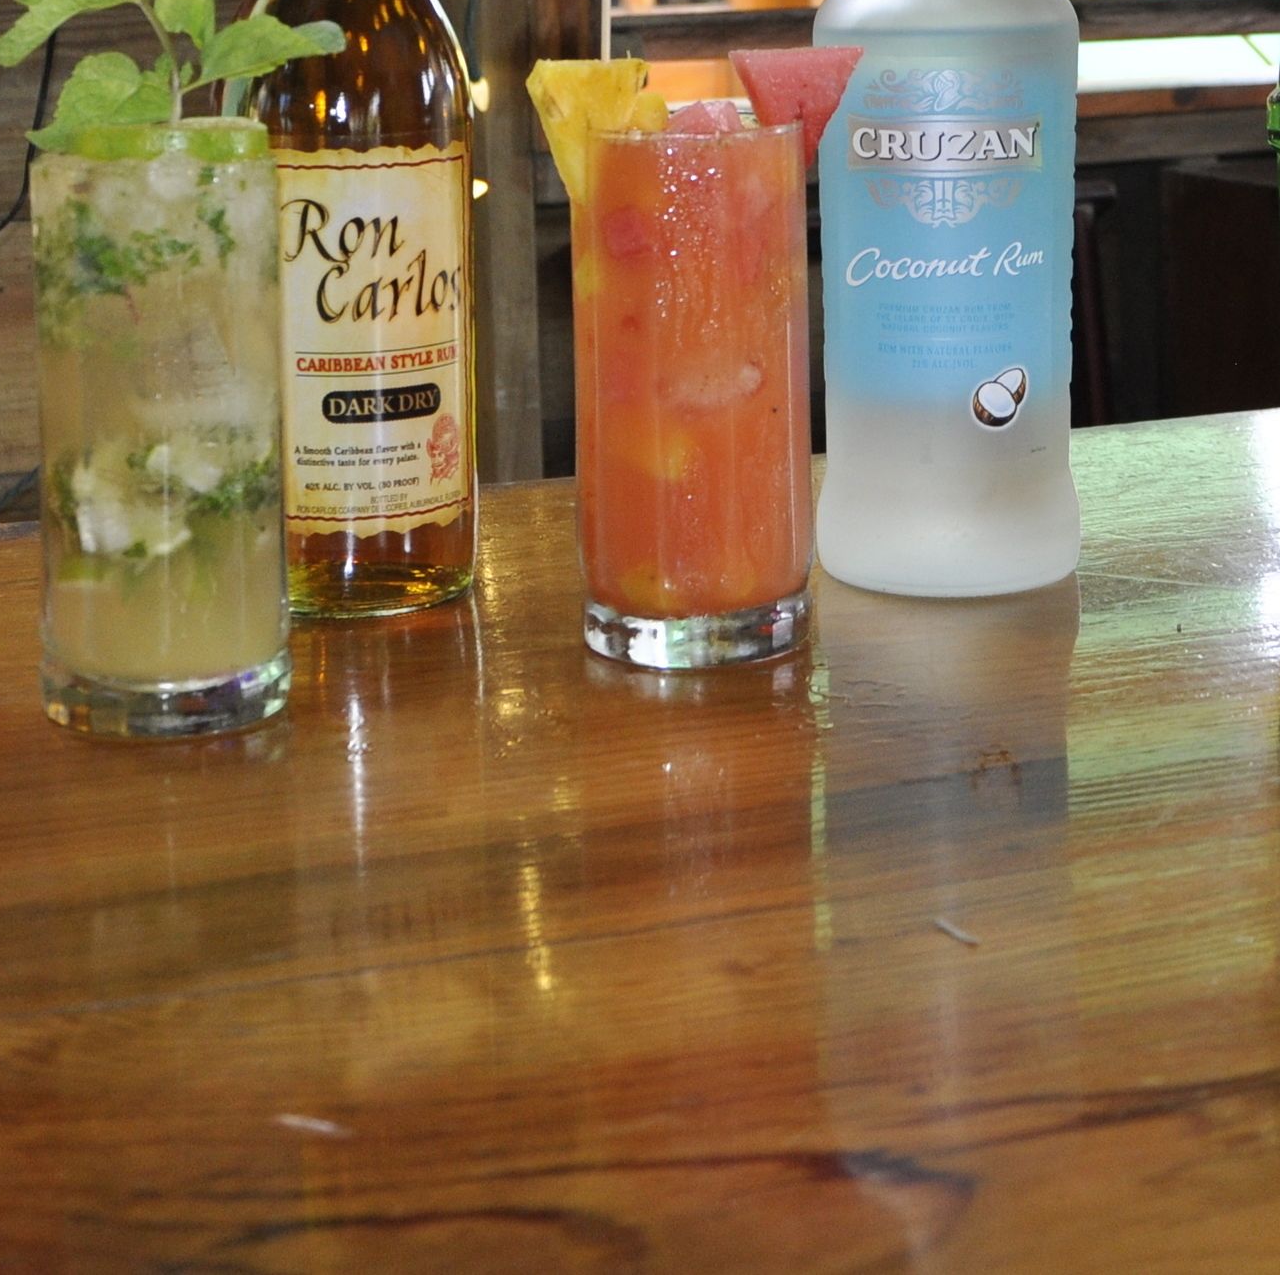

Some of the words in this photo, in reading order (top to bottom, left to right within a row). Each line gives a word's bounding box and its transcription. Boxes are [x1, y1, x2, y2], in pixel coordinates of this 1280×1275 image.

[851, 126, 1037, 162] CRUZAN
[281, 198, 406, 264] Ron
[845, 246, 992, 287] Coconut
[992, 241, 1044, 276] Rum
[316, 248, 462, 324] Carlos
[296, 356, 387, 373] CARIBBEAN
[390, 350, 434, 370] STYLE
[329, 397, 395, 417] DARK
[399, 389, 439, 412] DRY
[334, 445, 373, 456] Caribbean
[358, 456, 370, 467] for
